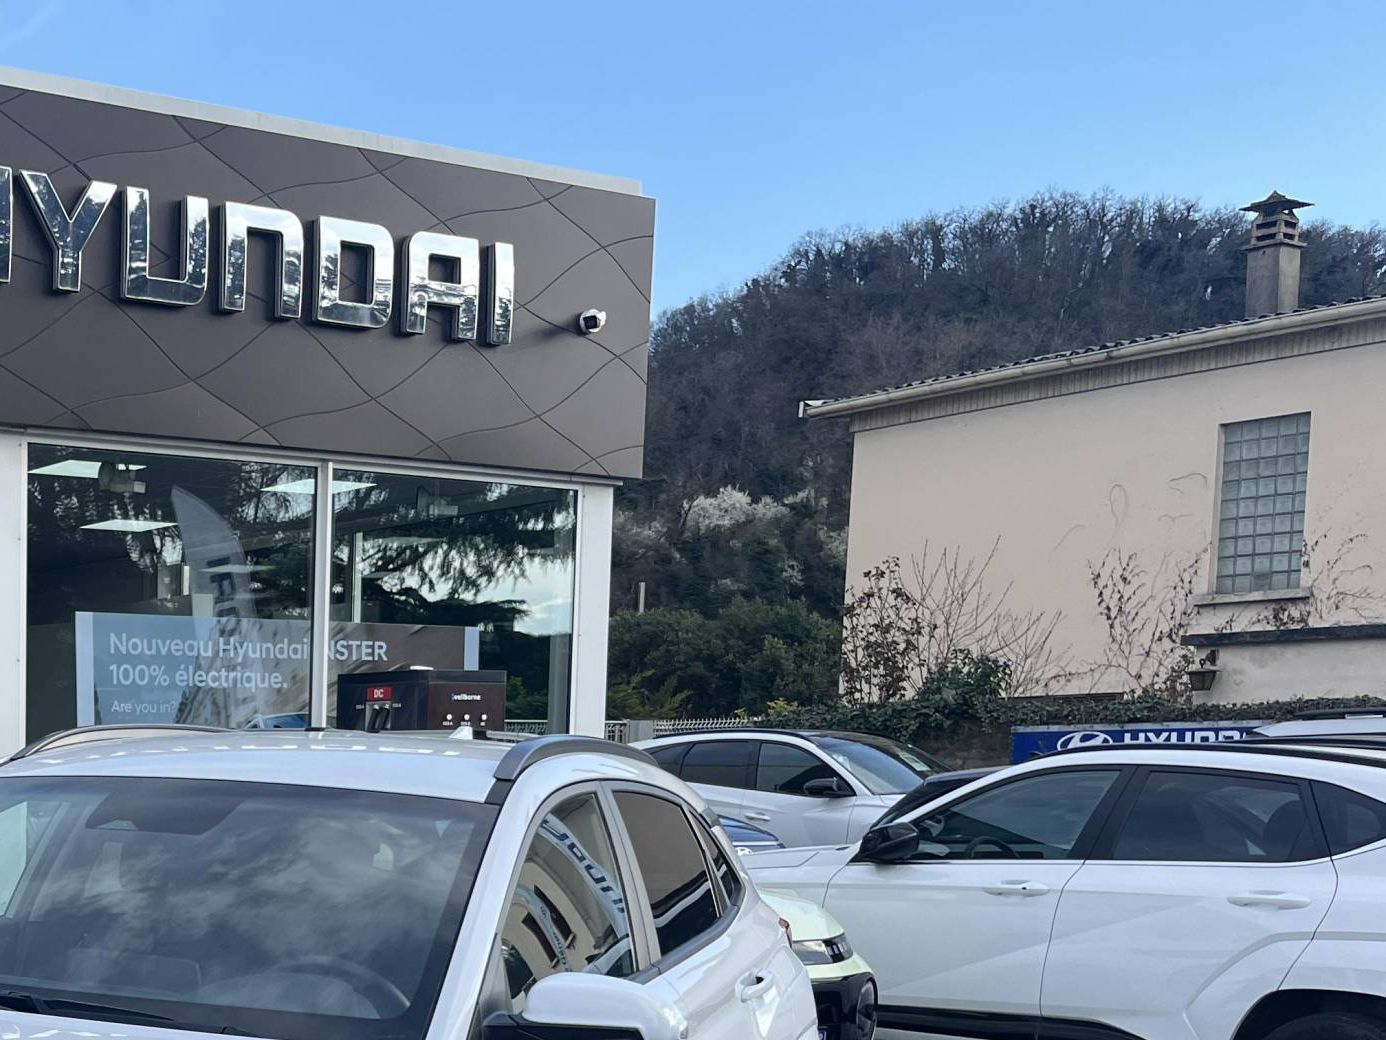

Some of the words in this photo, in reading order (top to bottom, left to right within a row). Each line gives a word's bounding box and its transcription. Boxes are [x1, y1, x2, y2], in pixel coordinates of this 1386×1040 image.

[109, 633, 213, 658] Nouveau
[218, 637, 308, 662] Hyundai
[328, 640, 389, 662] STER
[109, 664, 169, 687] 100%
[175, 663, 288, 692] électrique.
[373, 689, 384, 698] DC
[111, 700, 133, 713] Are
[134, 703, 156, 715] you
[157, 700, 176, 713] in?
